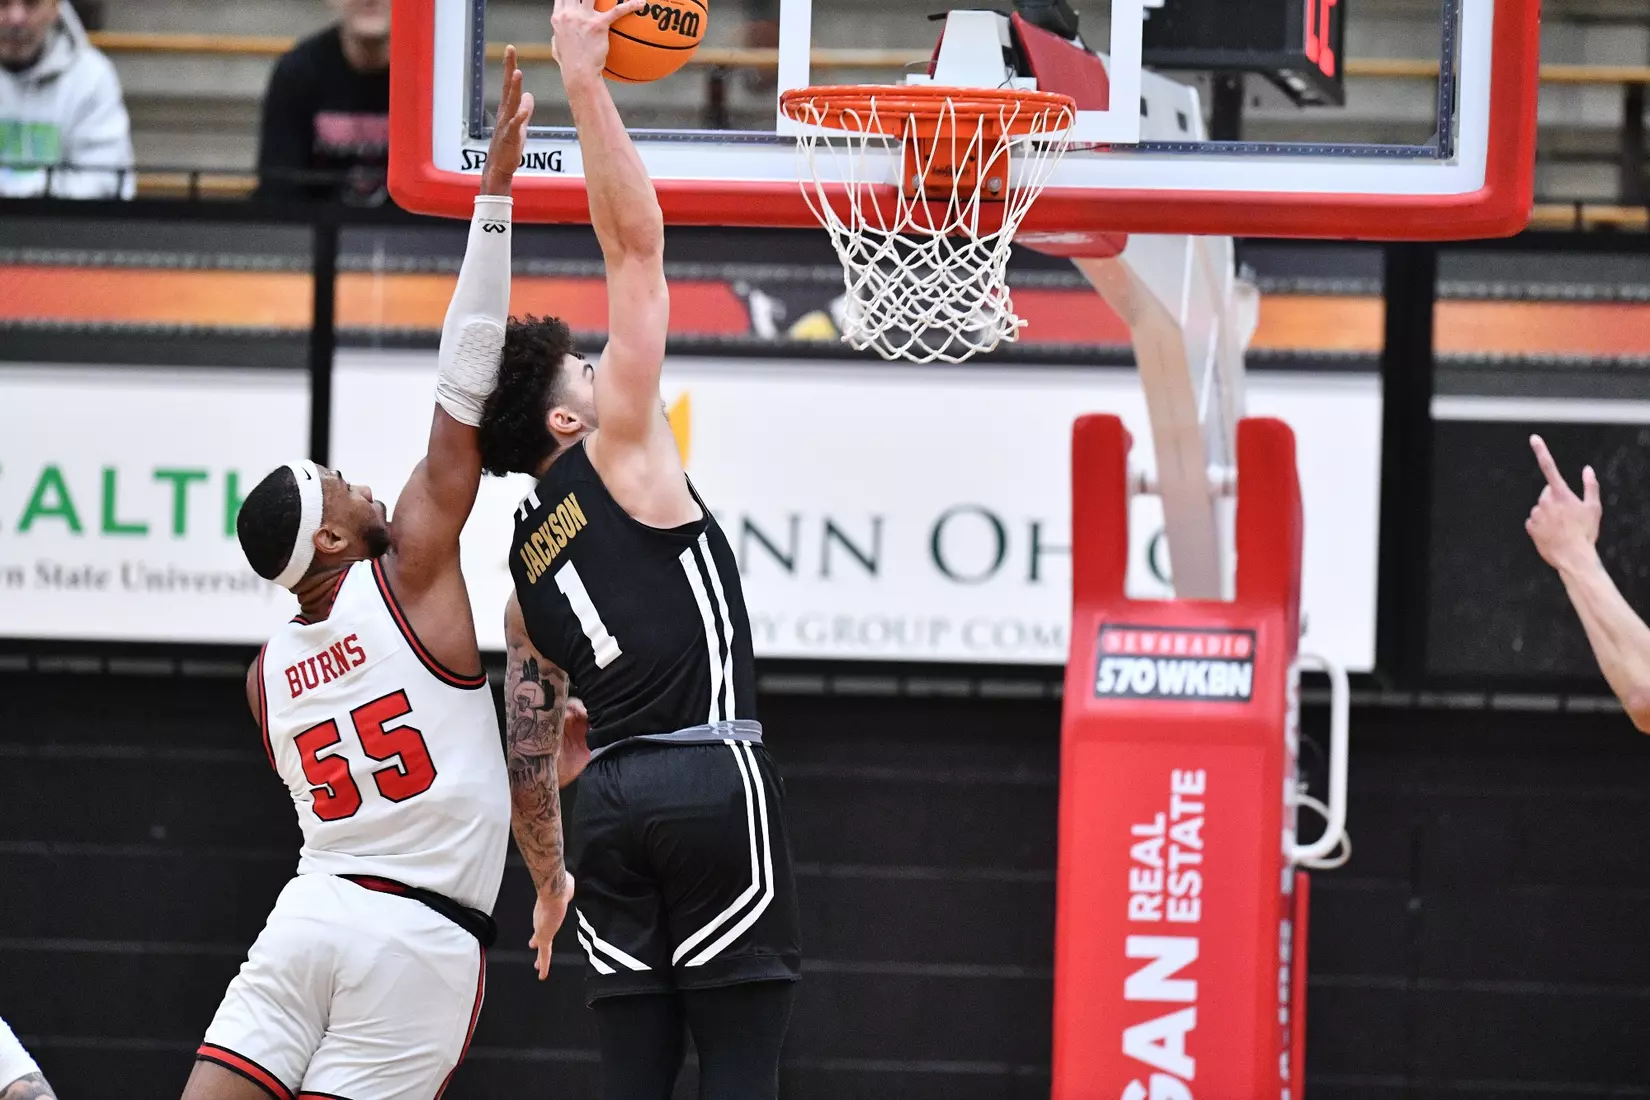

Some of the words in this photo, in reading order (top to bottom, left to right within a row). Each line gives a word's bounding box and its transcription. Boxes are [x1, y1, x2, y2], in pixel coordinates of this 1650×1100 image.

[616, 0, 700, 38] Wilso
[461, 148, 563, 173] SPING
[34, 559, 110, 590] State
[519, 491, 588, 585] JACKSON
[553, 559, 623, 670] 1
[961, 616, 1070, 651] COM
[284, 633, 367, 699] BURNS
[293, 688, 438, 822] 55
[1127, 811, 1167, 922] REAL
[1165, 768, 1207, 923] ESTATE
